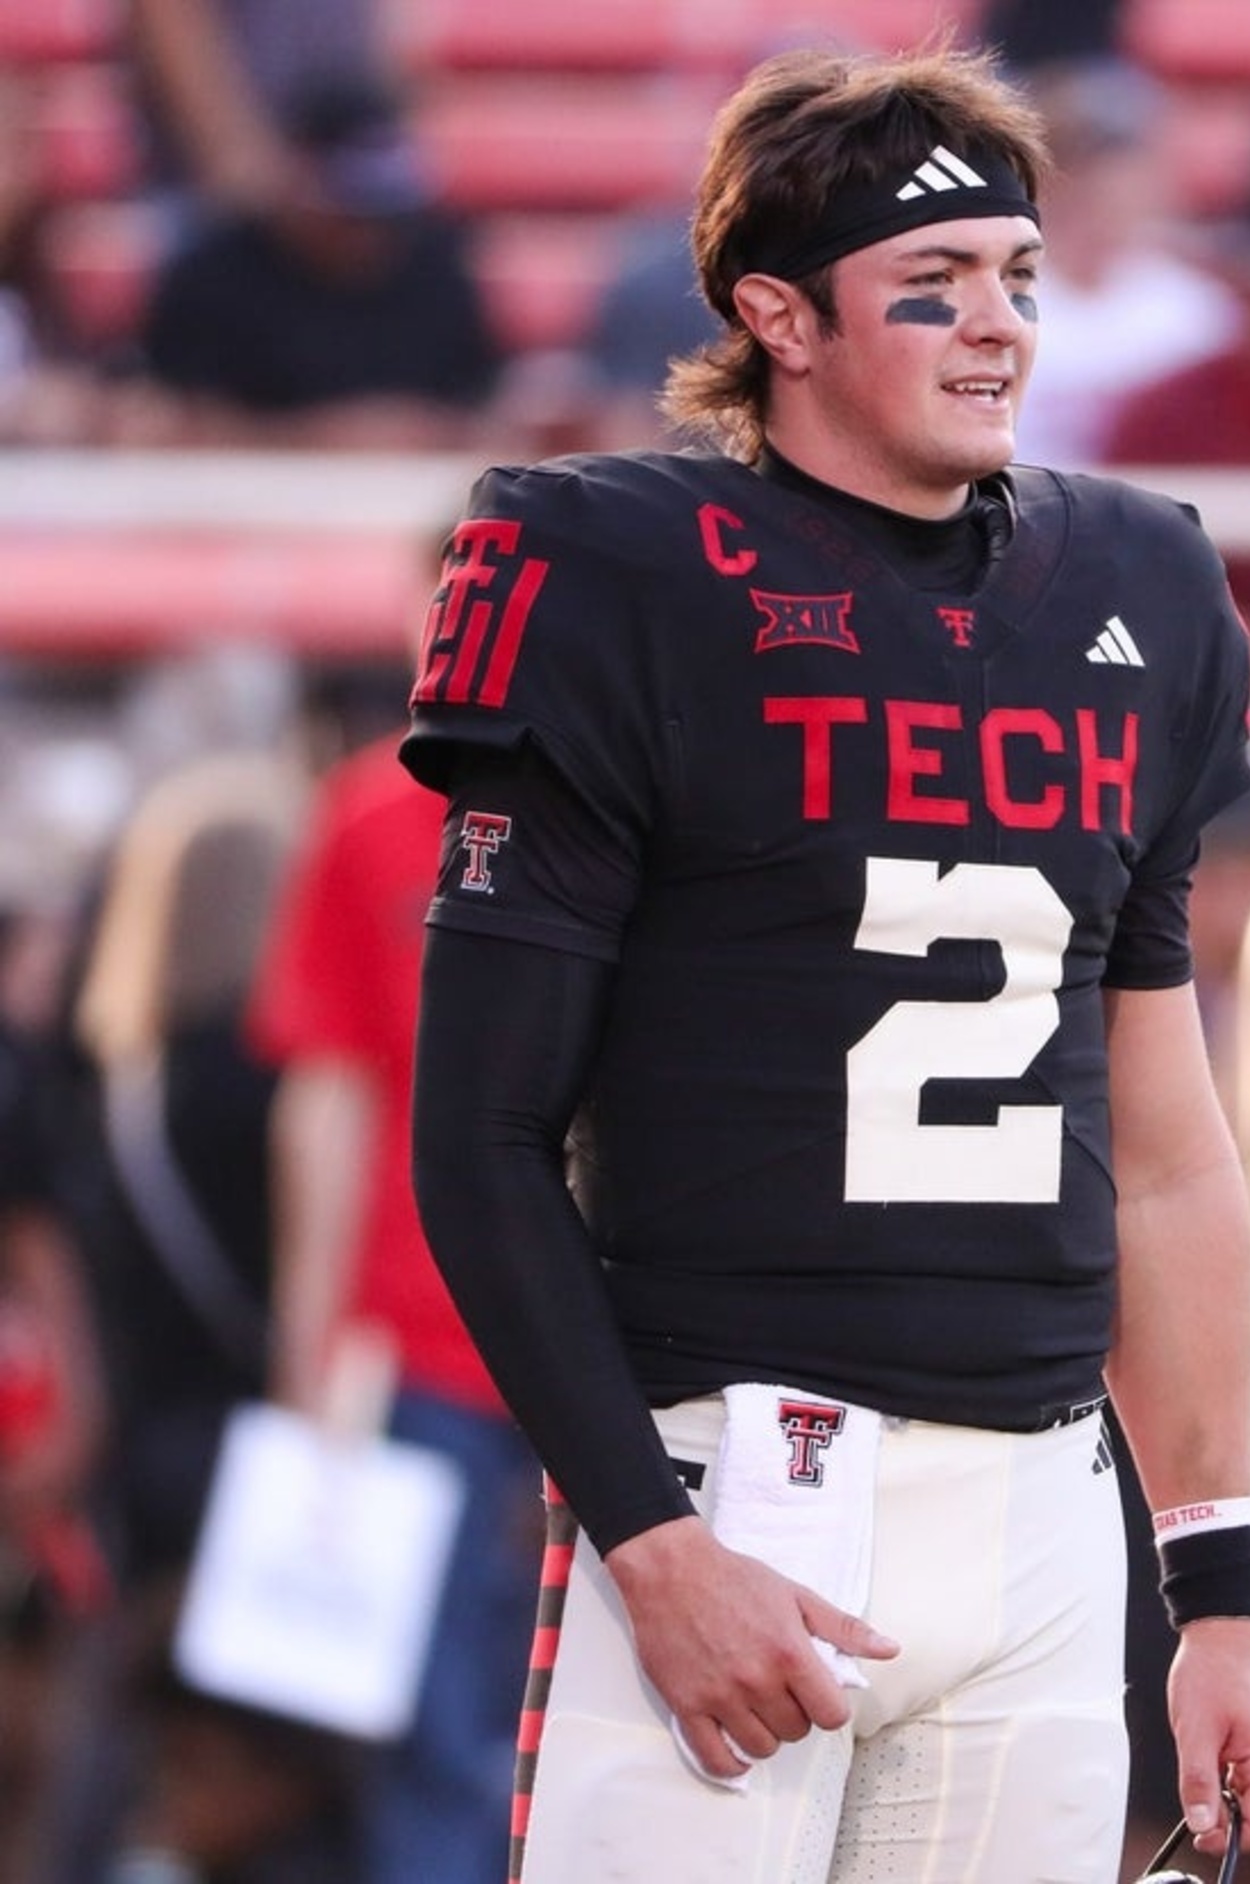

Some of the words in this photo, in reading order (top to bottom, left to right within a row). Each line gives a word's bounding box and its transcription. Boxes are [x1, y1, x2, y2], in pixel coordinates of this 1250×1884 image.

[698, 503, 758, 577] C
[763, 697, 1140, 836] TECH
[844, 856, 1075, 1203] 2
